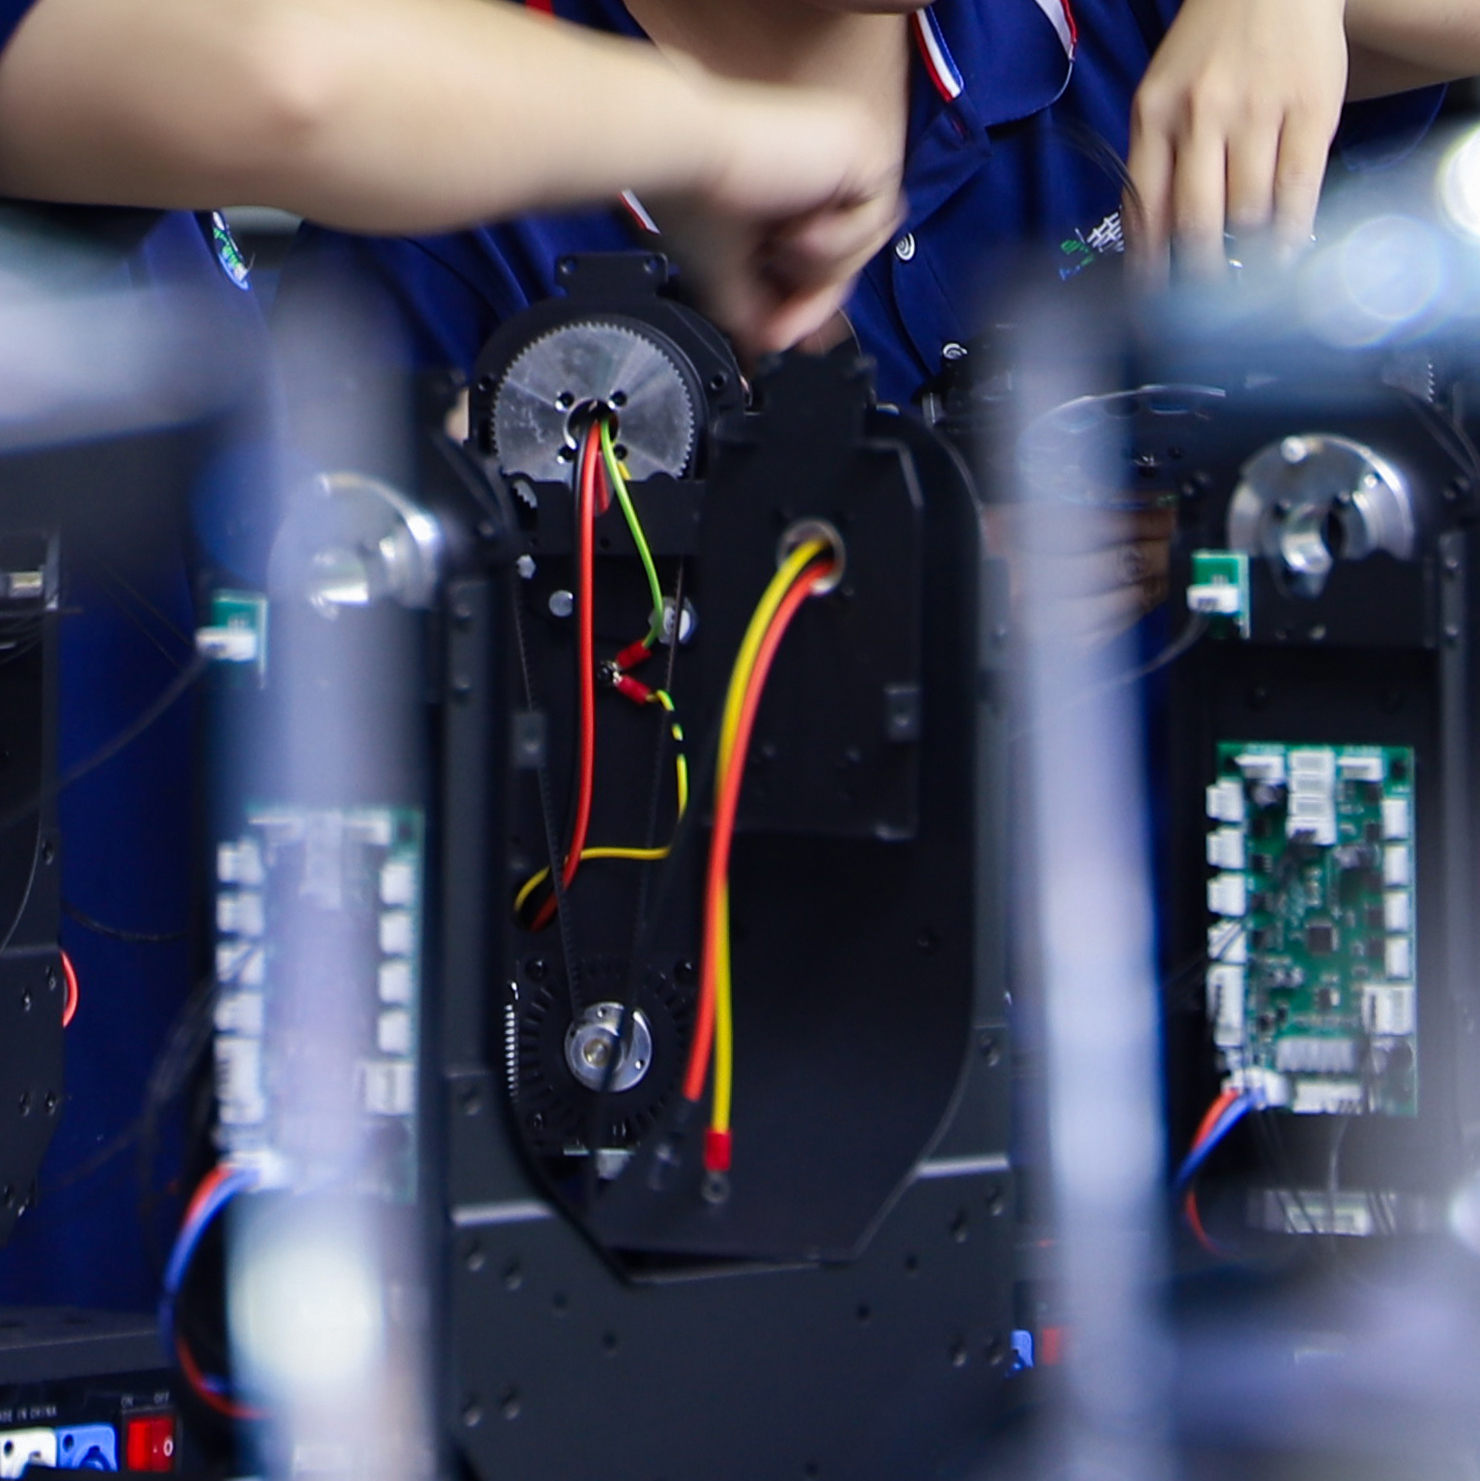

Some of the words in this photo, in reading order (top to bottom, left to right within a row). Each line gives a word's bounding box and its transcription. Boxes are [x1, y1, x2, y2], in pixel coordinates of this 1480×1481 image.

[121, 1394, 134, 1408] ON
[153, 1391, 170, 1405] OFF
[17, 1407, 27, 1421] IN
[30, 1404, 57, 1419] CHINA
